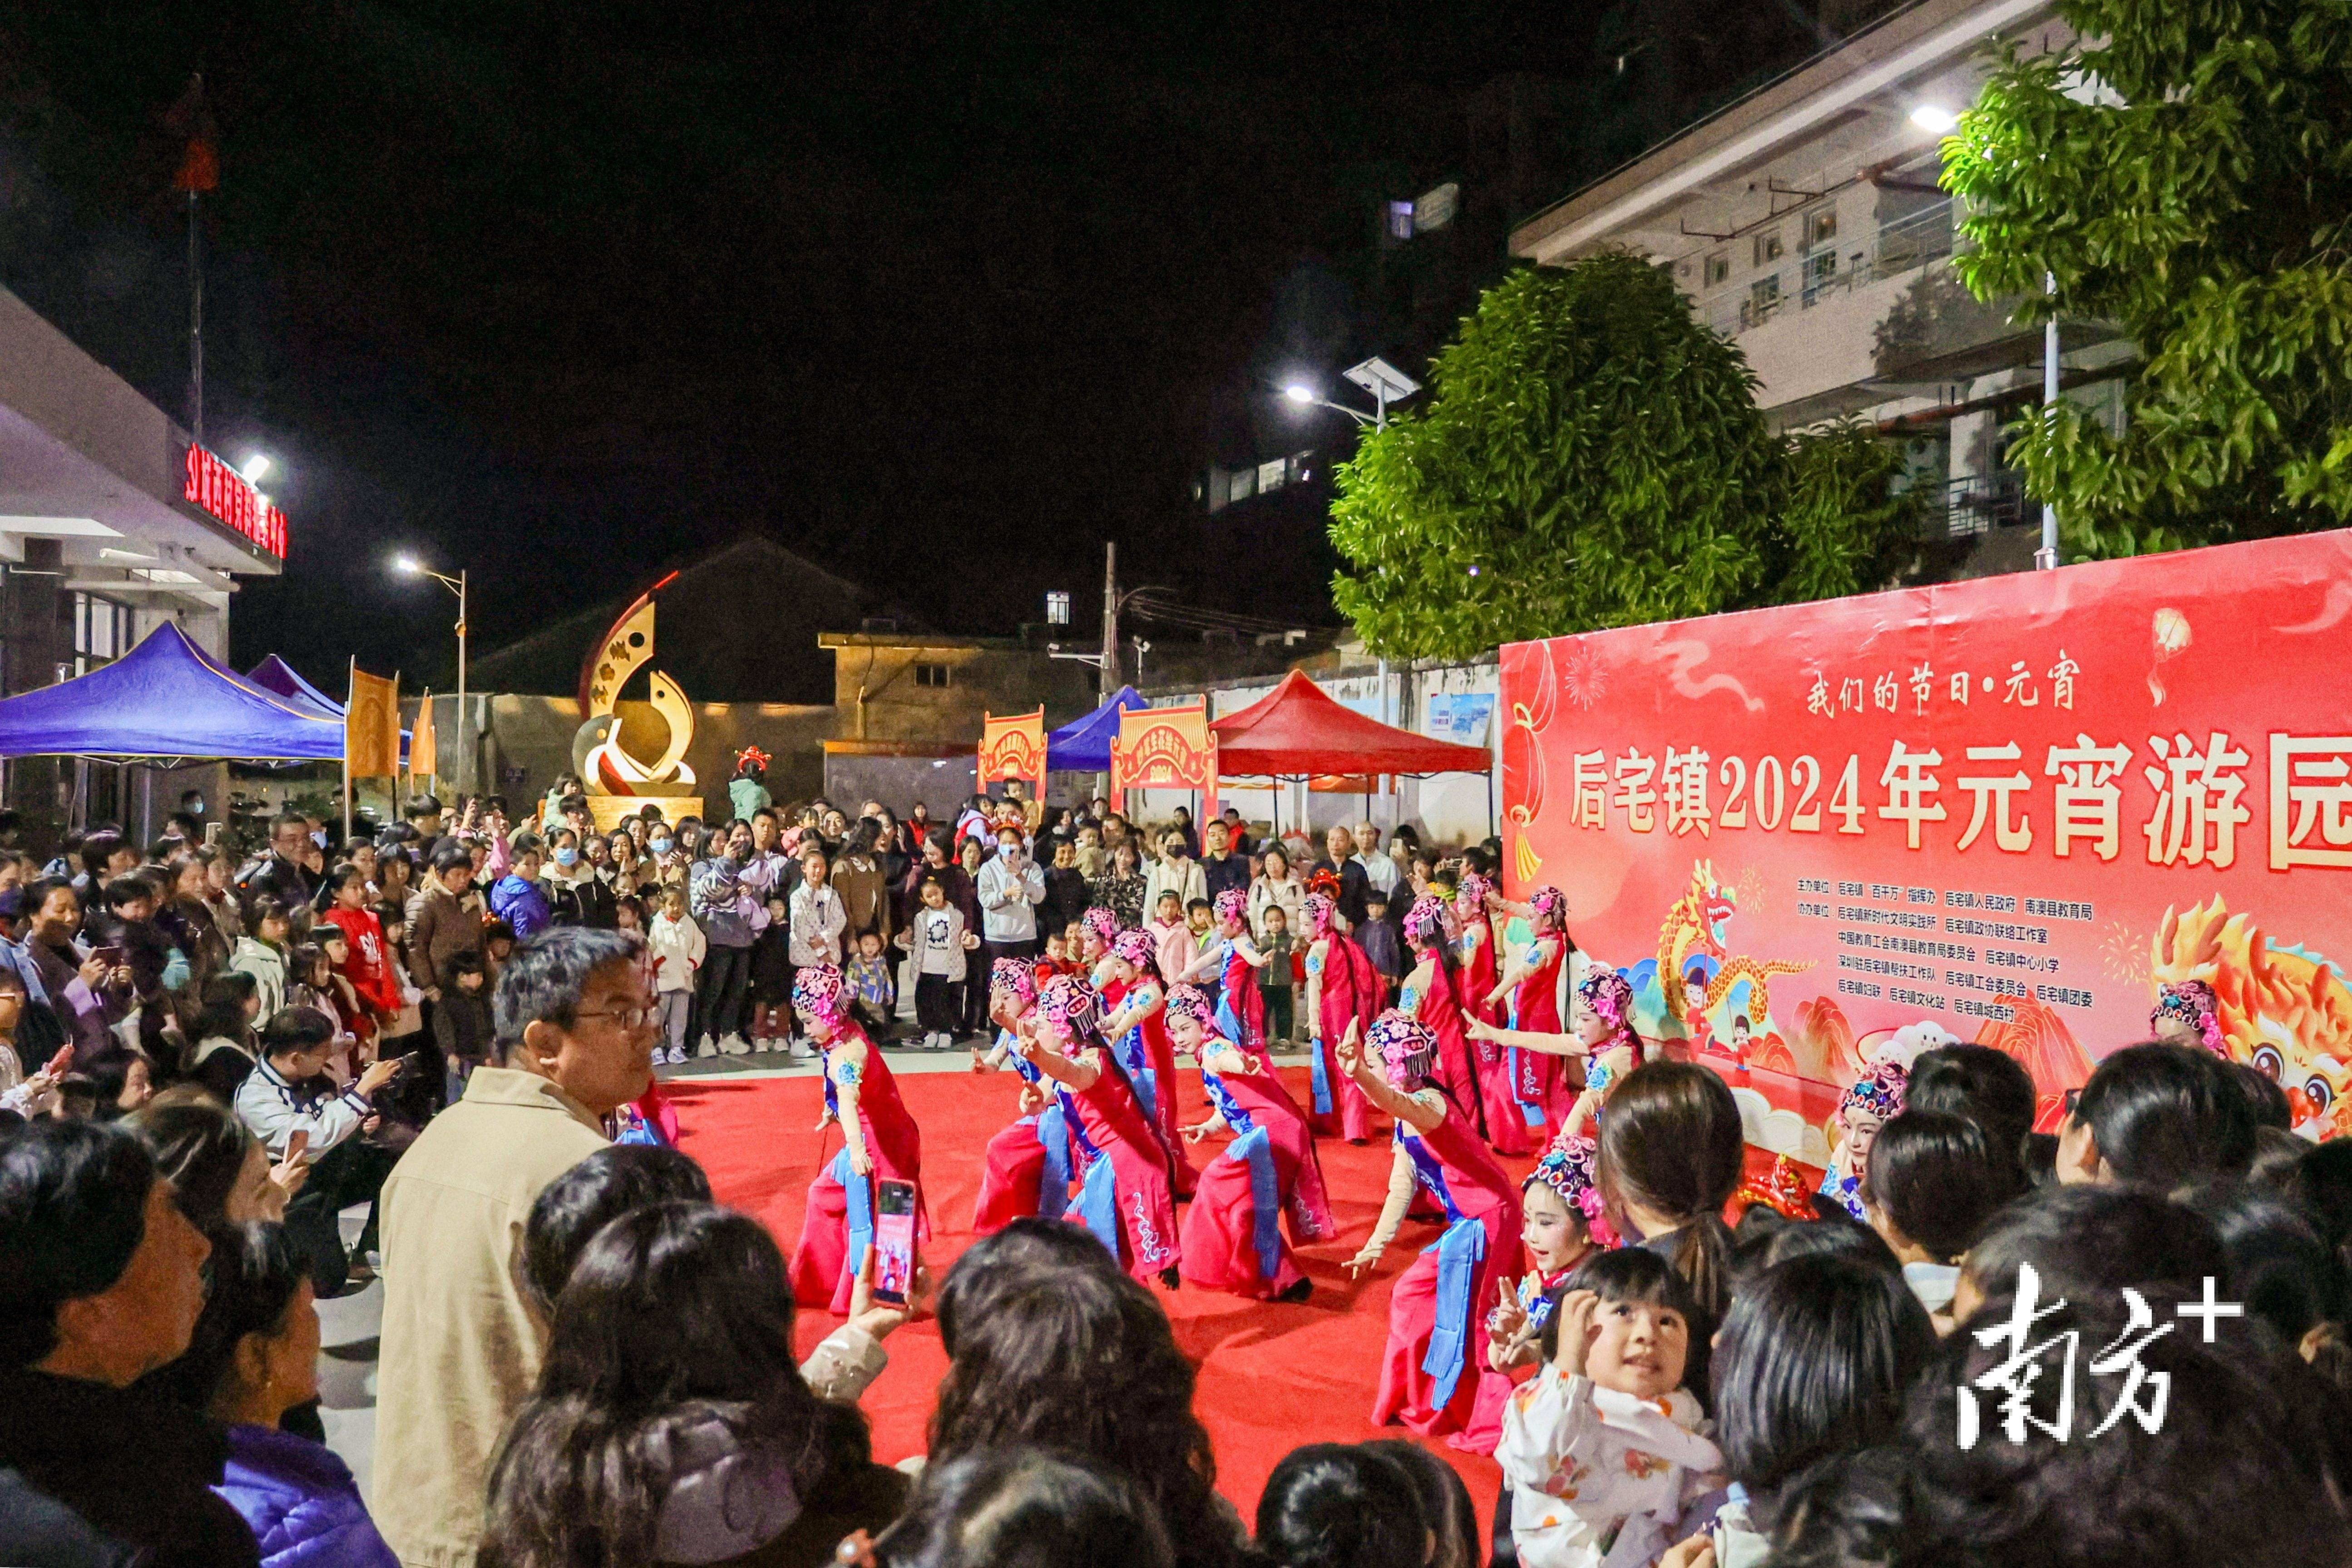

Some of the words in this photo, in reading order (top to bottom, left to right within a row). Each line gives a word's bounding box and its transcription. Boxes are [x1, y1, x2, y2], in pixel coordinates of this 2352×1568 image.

[1806, 649, 2081, 719] 我们的节日·元宵
[1150, 765, 1172, 783] 2024
[1570, 732, 2352, 870] 后宅镇2024年元宵游园
[1945, 892, 2016, 912] 后宅镇人民政府
[2026, 898, 2092, 920] 南澳县教育局
[1945, 918, 2048, 944] 后宅镇政协联络工作室
[1838, 932, 1976, 962] 中国教育工会南澳县教育局委员会
[1985, 950, 2059, 973] 后宅镇中心小学
[1838, 954, 1937, 982] 深圳驻后宅镇帮扶工作队
[1945, 971, 2026, 996] 后宅镇工会委员会
[2036, 985, 2093, 1008] 后宅镇团委
[1838, 979, 1881, 998] 后宅镇妇联
[1888, 987, 1945, 1010] 后宅镇文化站
[1953, 999, 2015, 1023] 后宅镇城西村
